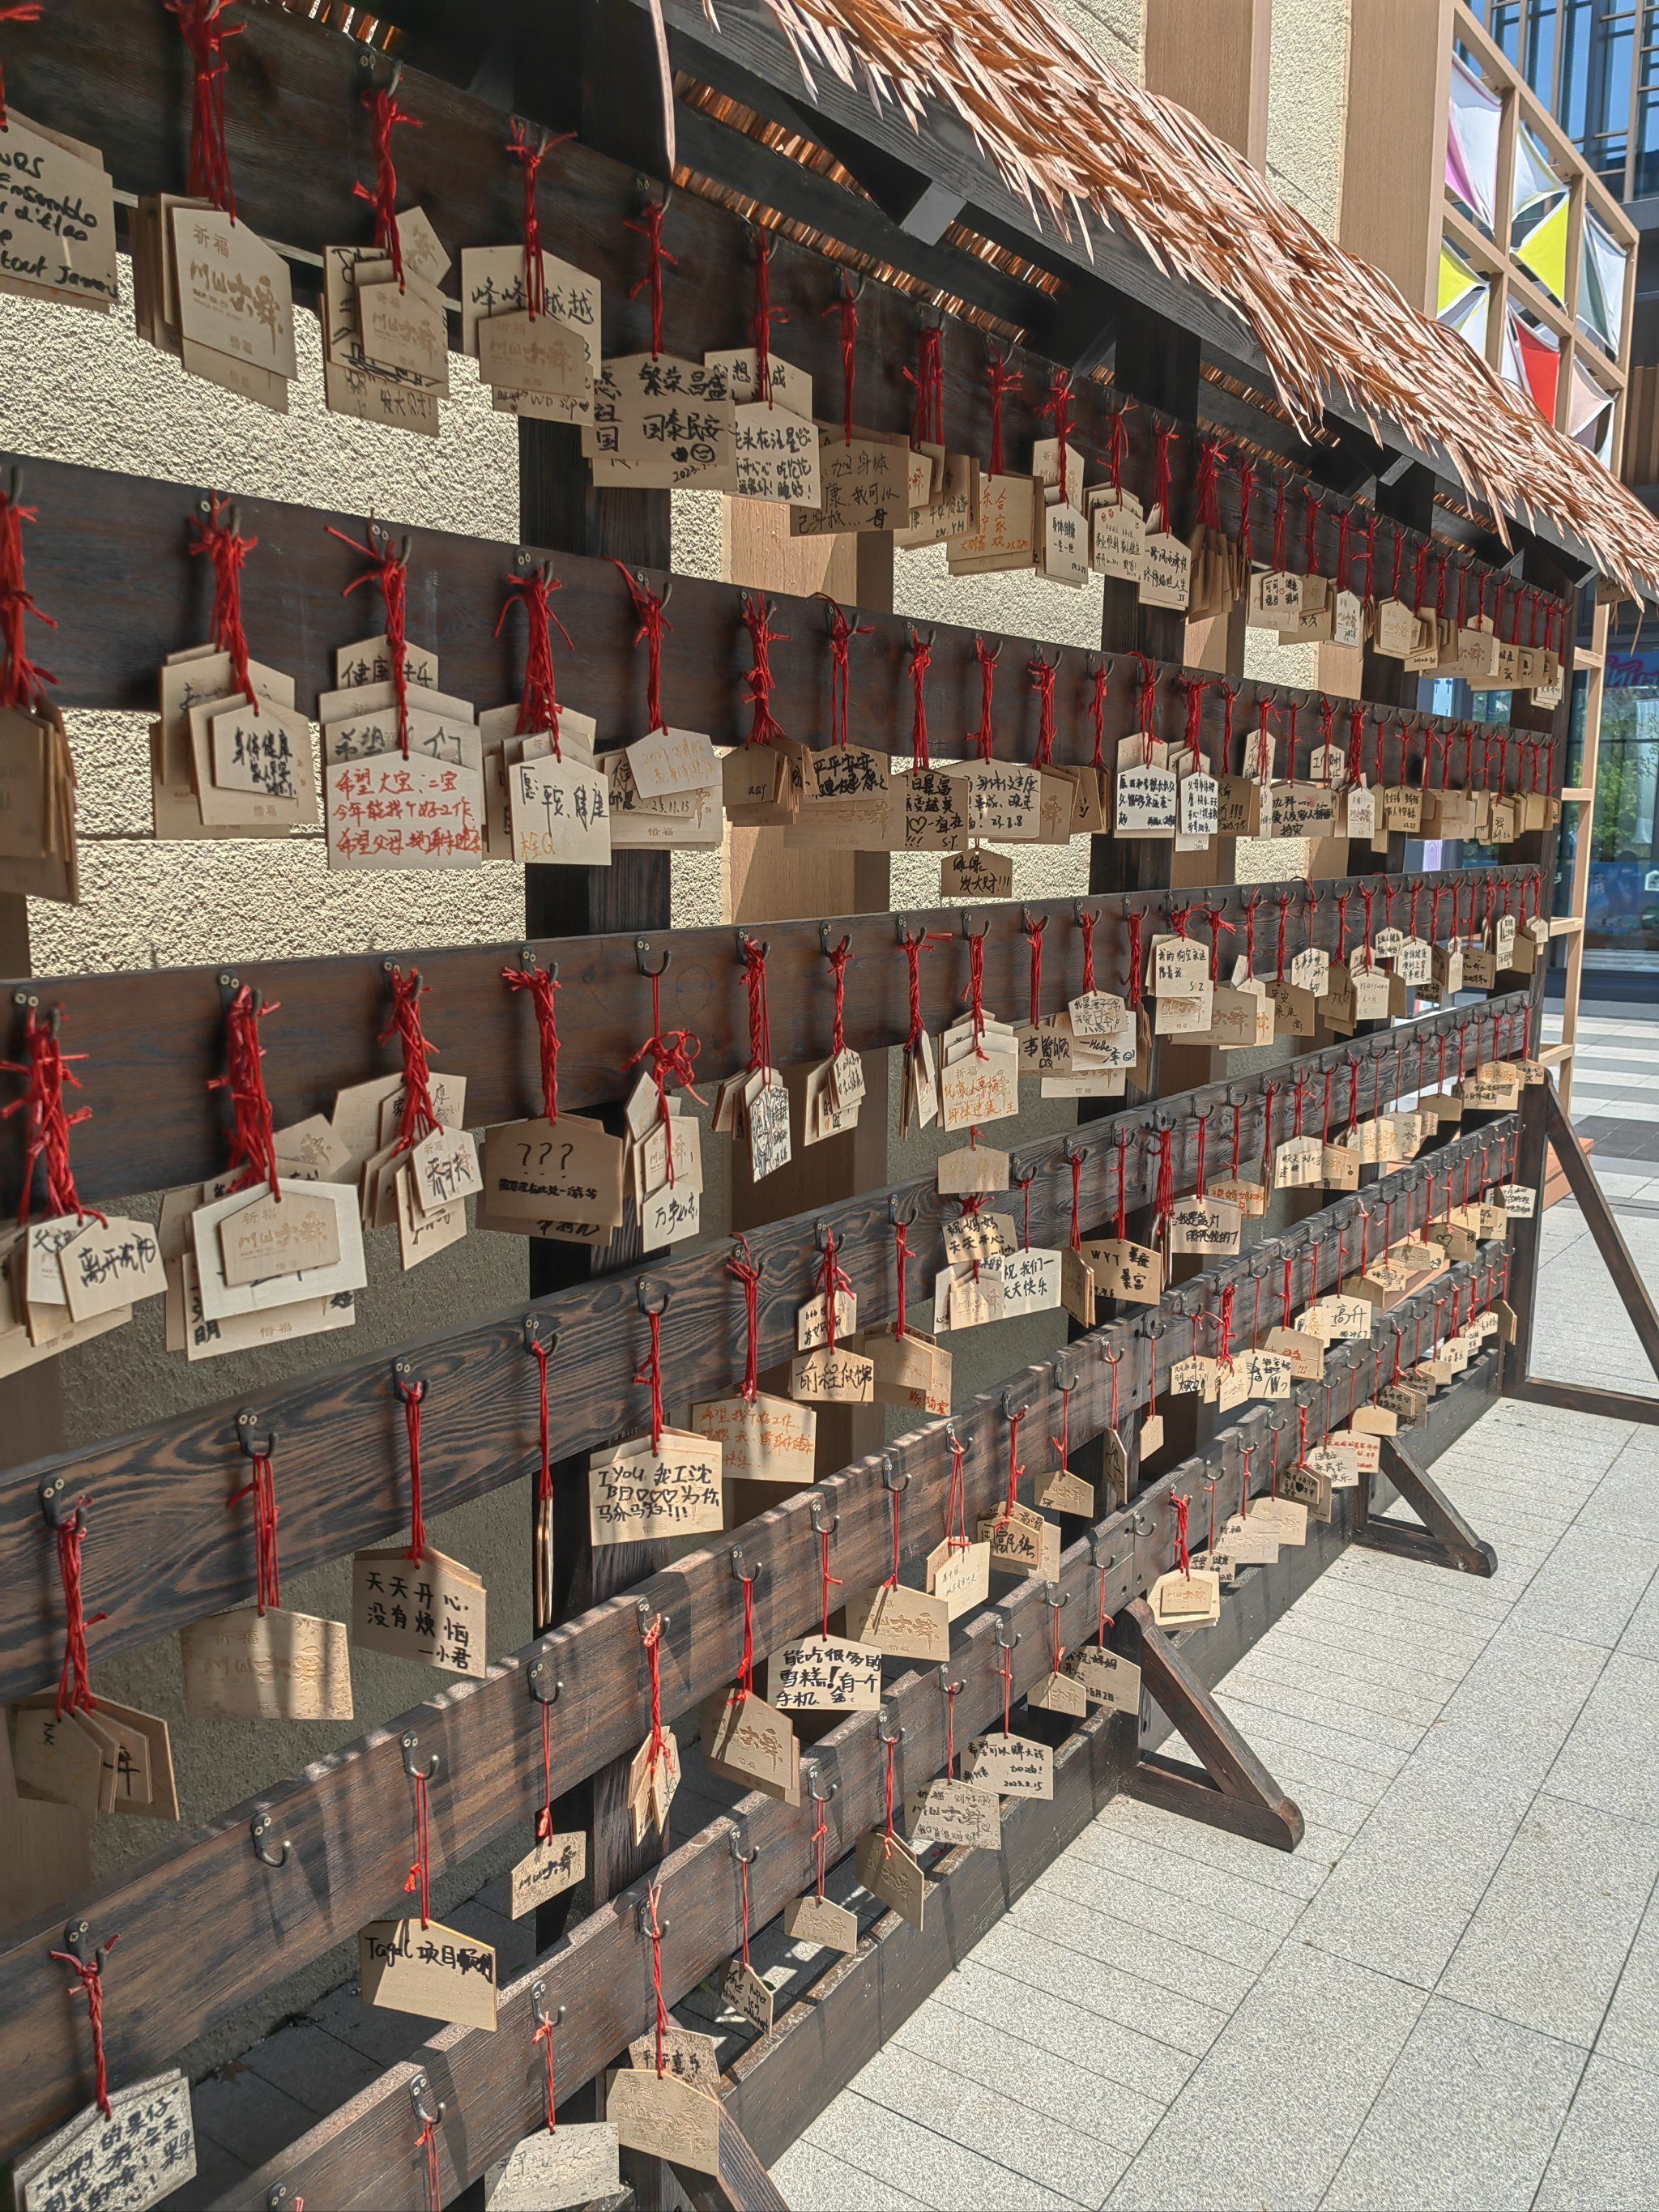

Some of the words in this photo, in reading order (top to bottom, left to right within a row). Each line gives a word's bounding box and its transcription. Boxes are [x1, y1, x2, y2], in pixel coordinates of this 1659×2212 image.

[193, 223, 230, 258] 祈福
[638, 361, 727, 403] 繁荣昌盛
[642, 407, 724, 443] 国泰民安
[1053, 542, 1075, 555] 一生一世
[335, 767, 458, 801] 希望大宝、二宝
[79, 1233, 157, 1288] 离开沈阳
[949, 1235, 1005, 1255] 天天开心
[795, 1360, 873, 1403] 前程似锦
[366, 1604, 469, 1645] 没有烦恼
[783, 1645, 883, 1669] 能吃很多的
